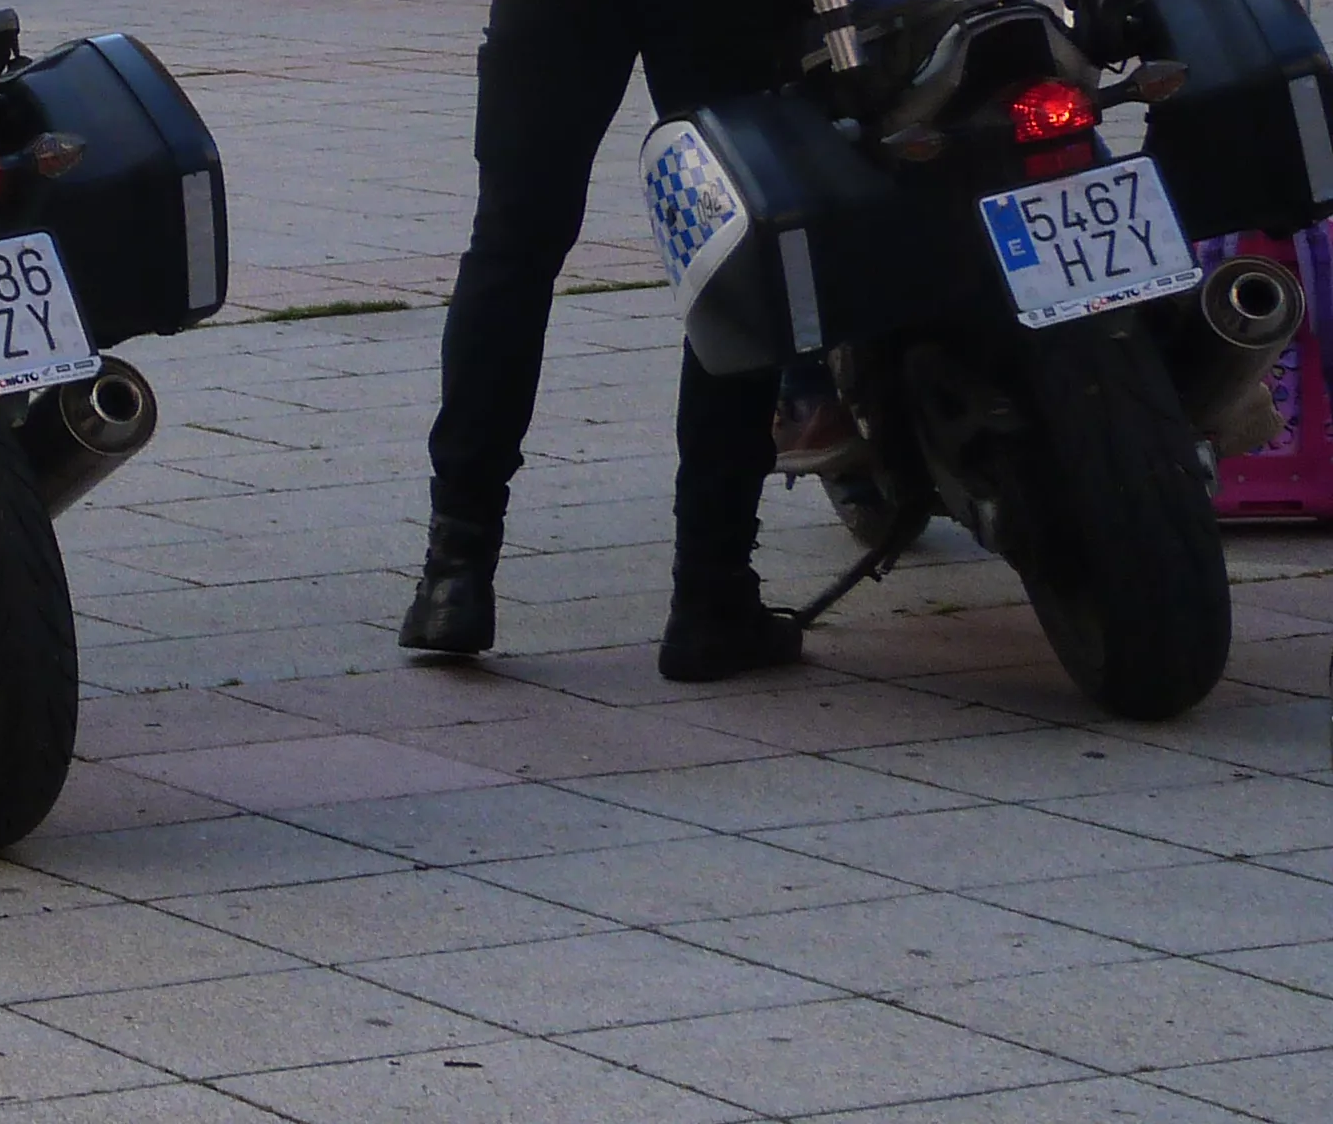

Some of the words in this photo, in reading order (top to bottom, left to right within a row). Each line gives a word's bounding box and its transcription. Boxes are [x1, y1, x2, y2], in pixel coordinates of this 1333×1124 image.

[1020, 171, 1139, 242] 5467
[1007, 238, 1027, 257] E
[1054, 220, 1158, 287] HZY
